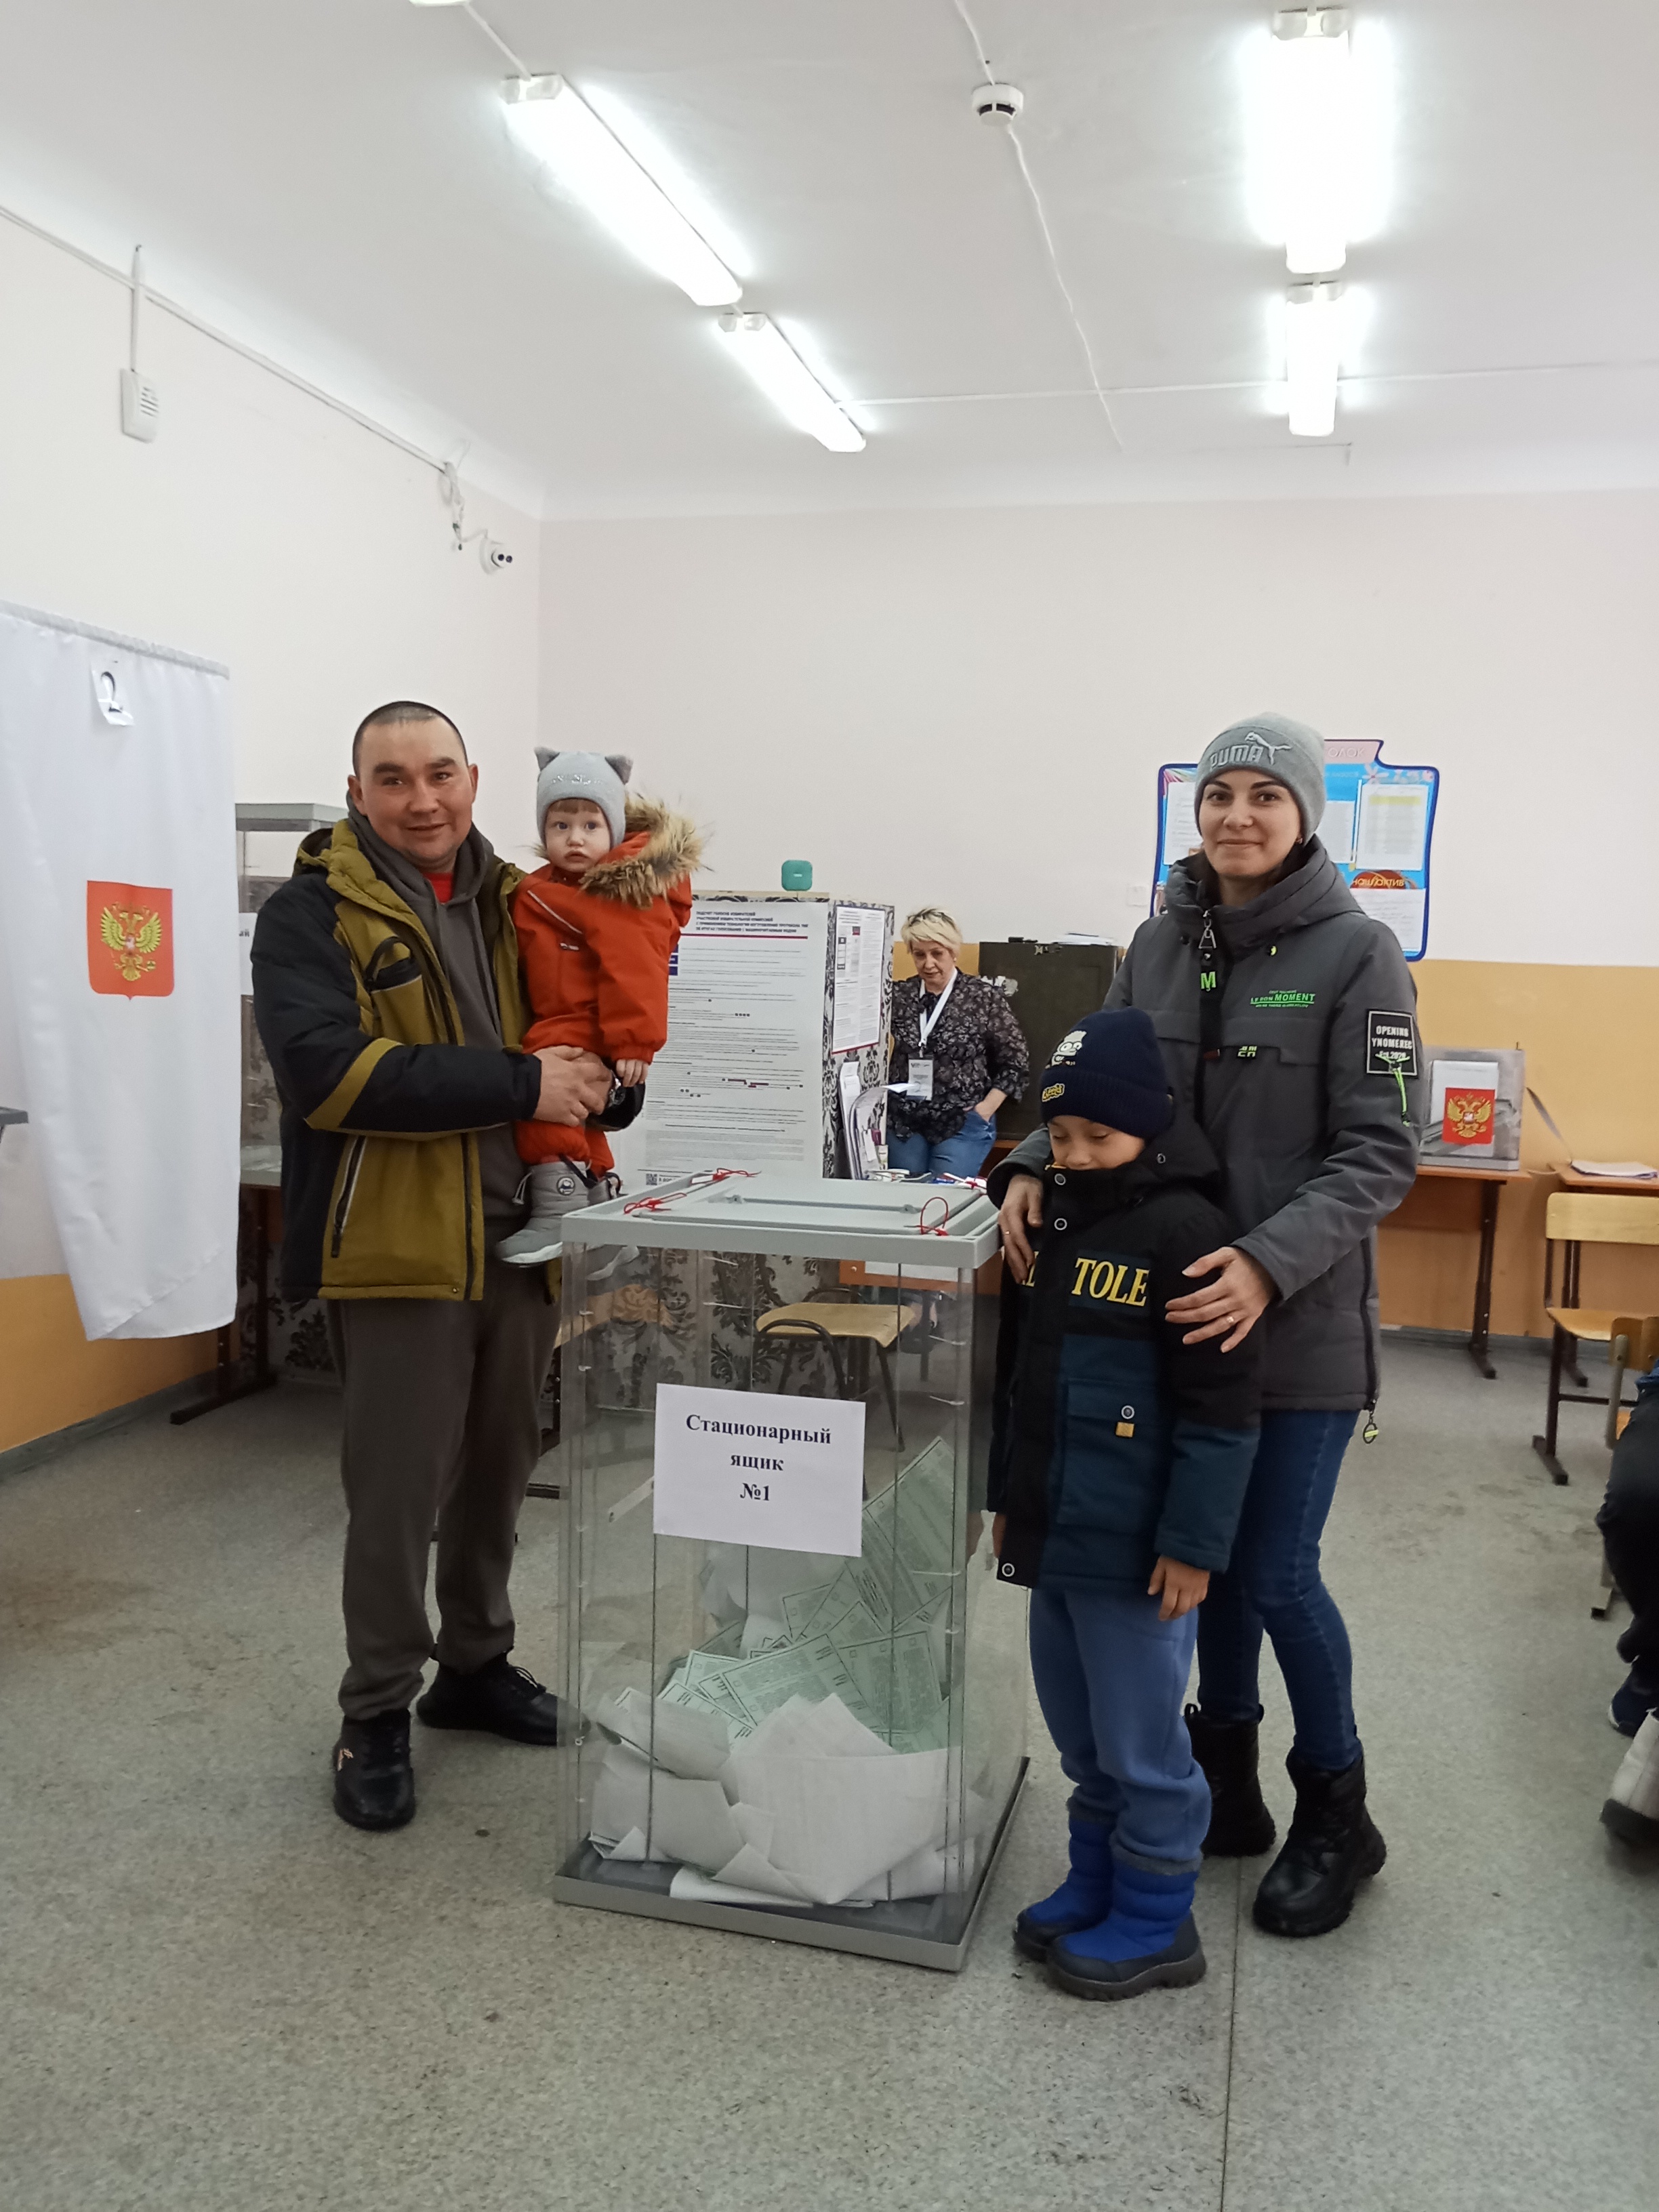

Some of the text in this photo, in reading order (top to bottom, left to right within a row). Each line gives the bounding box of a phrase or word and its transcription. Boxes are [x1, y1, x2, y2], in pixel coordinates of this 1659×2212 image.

[1210, 744, 1264, 771] PUMA
[1274, 993, 1316, 1002] MOMENT
[1071, 1257, 1150, 1307] TOLE
[686, 1414, 832, 1445] Стационарный
[729, 1454, 784, 1472] ящик
[739, 1482, 771, 1502] №1
